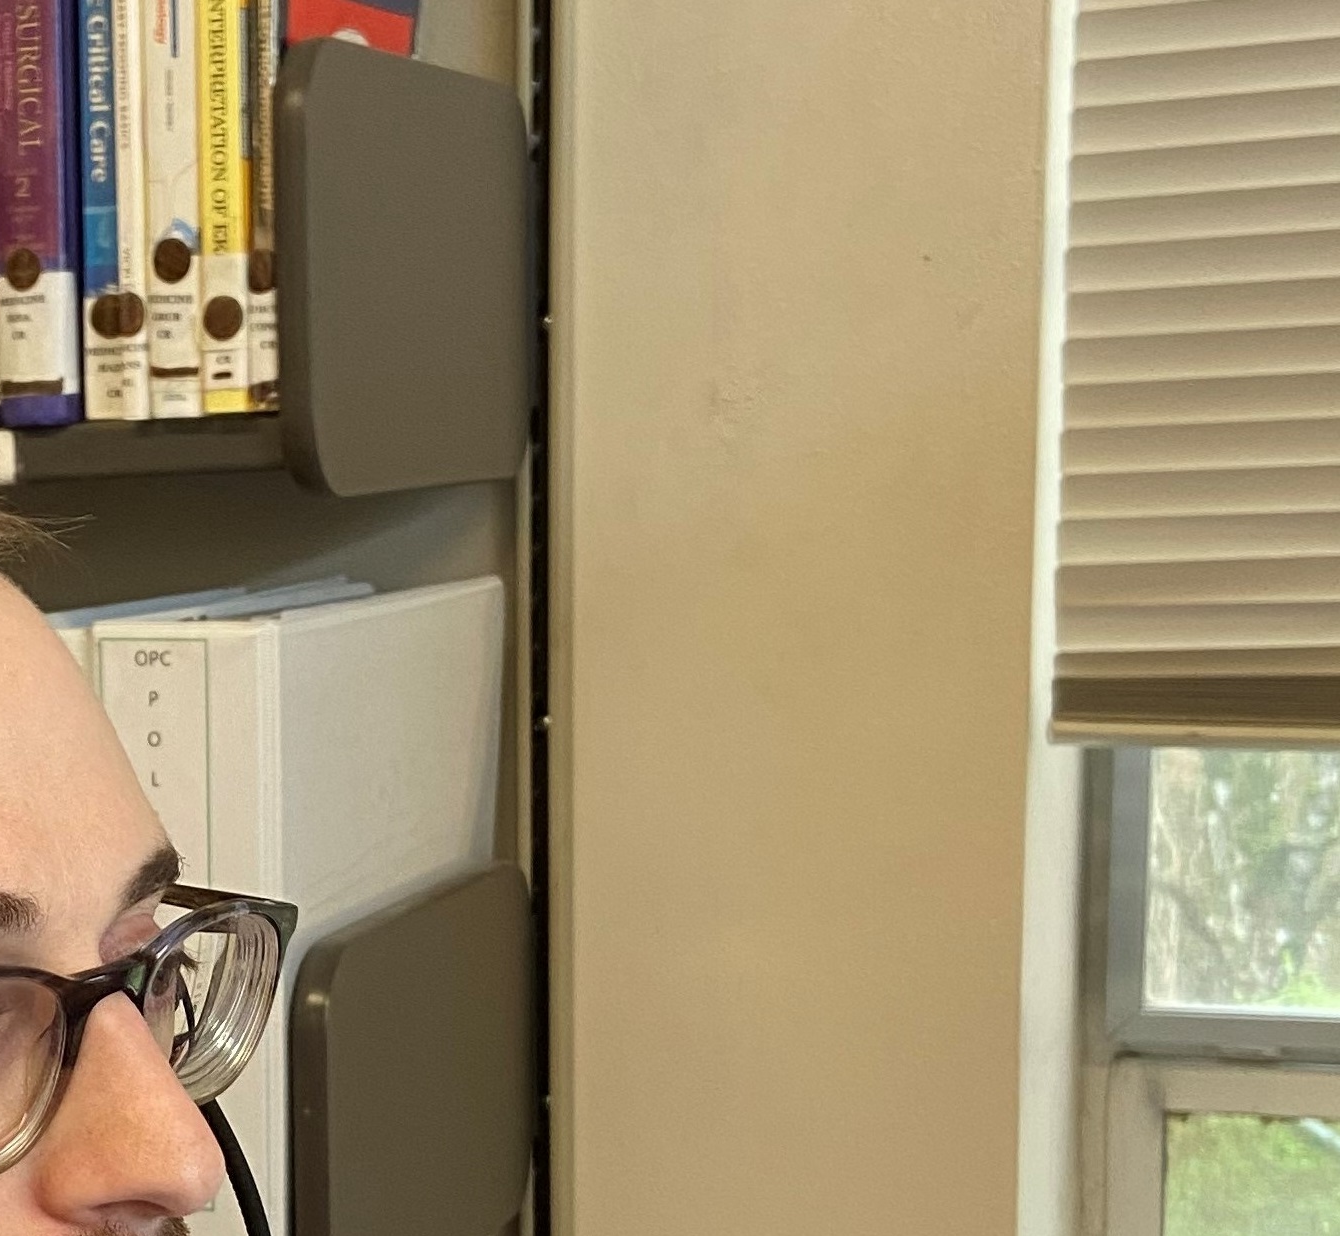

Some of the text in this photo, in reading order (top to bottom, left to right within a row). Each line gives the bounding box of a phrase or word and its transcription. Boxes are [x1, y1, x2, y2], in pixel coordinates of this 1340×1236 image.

[14, 4, 44, 156] SURGICAL
[85, 15, 112, 184] Critical Care
[14, 177, 32, 199] 2
[211, 187, 229, 218] OF
[211, 224, 230, 256] EK
[133, 649, 171, 668] OPC
